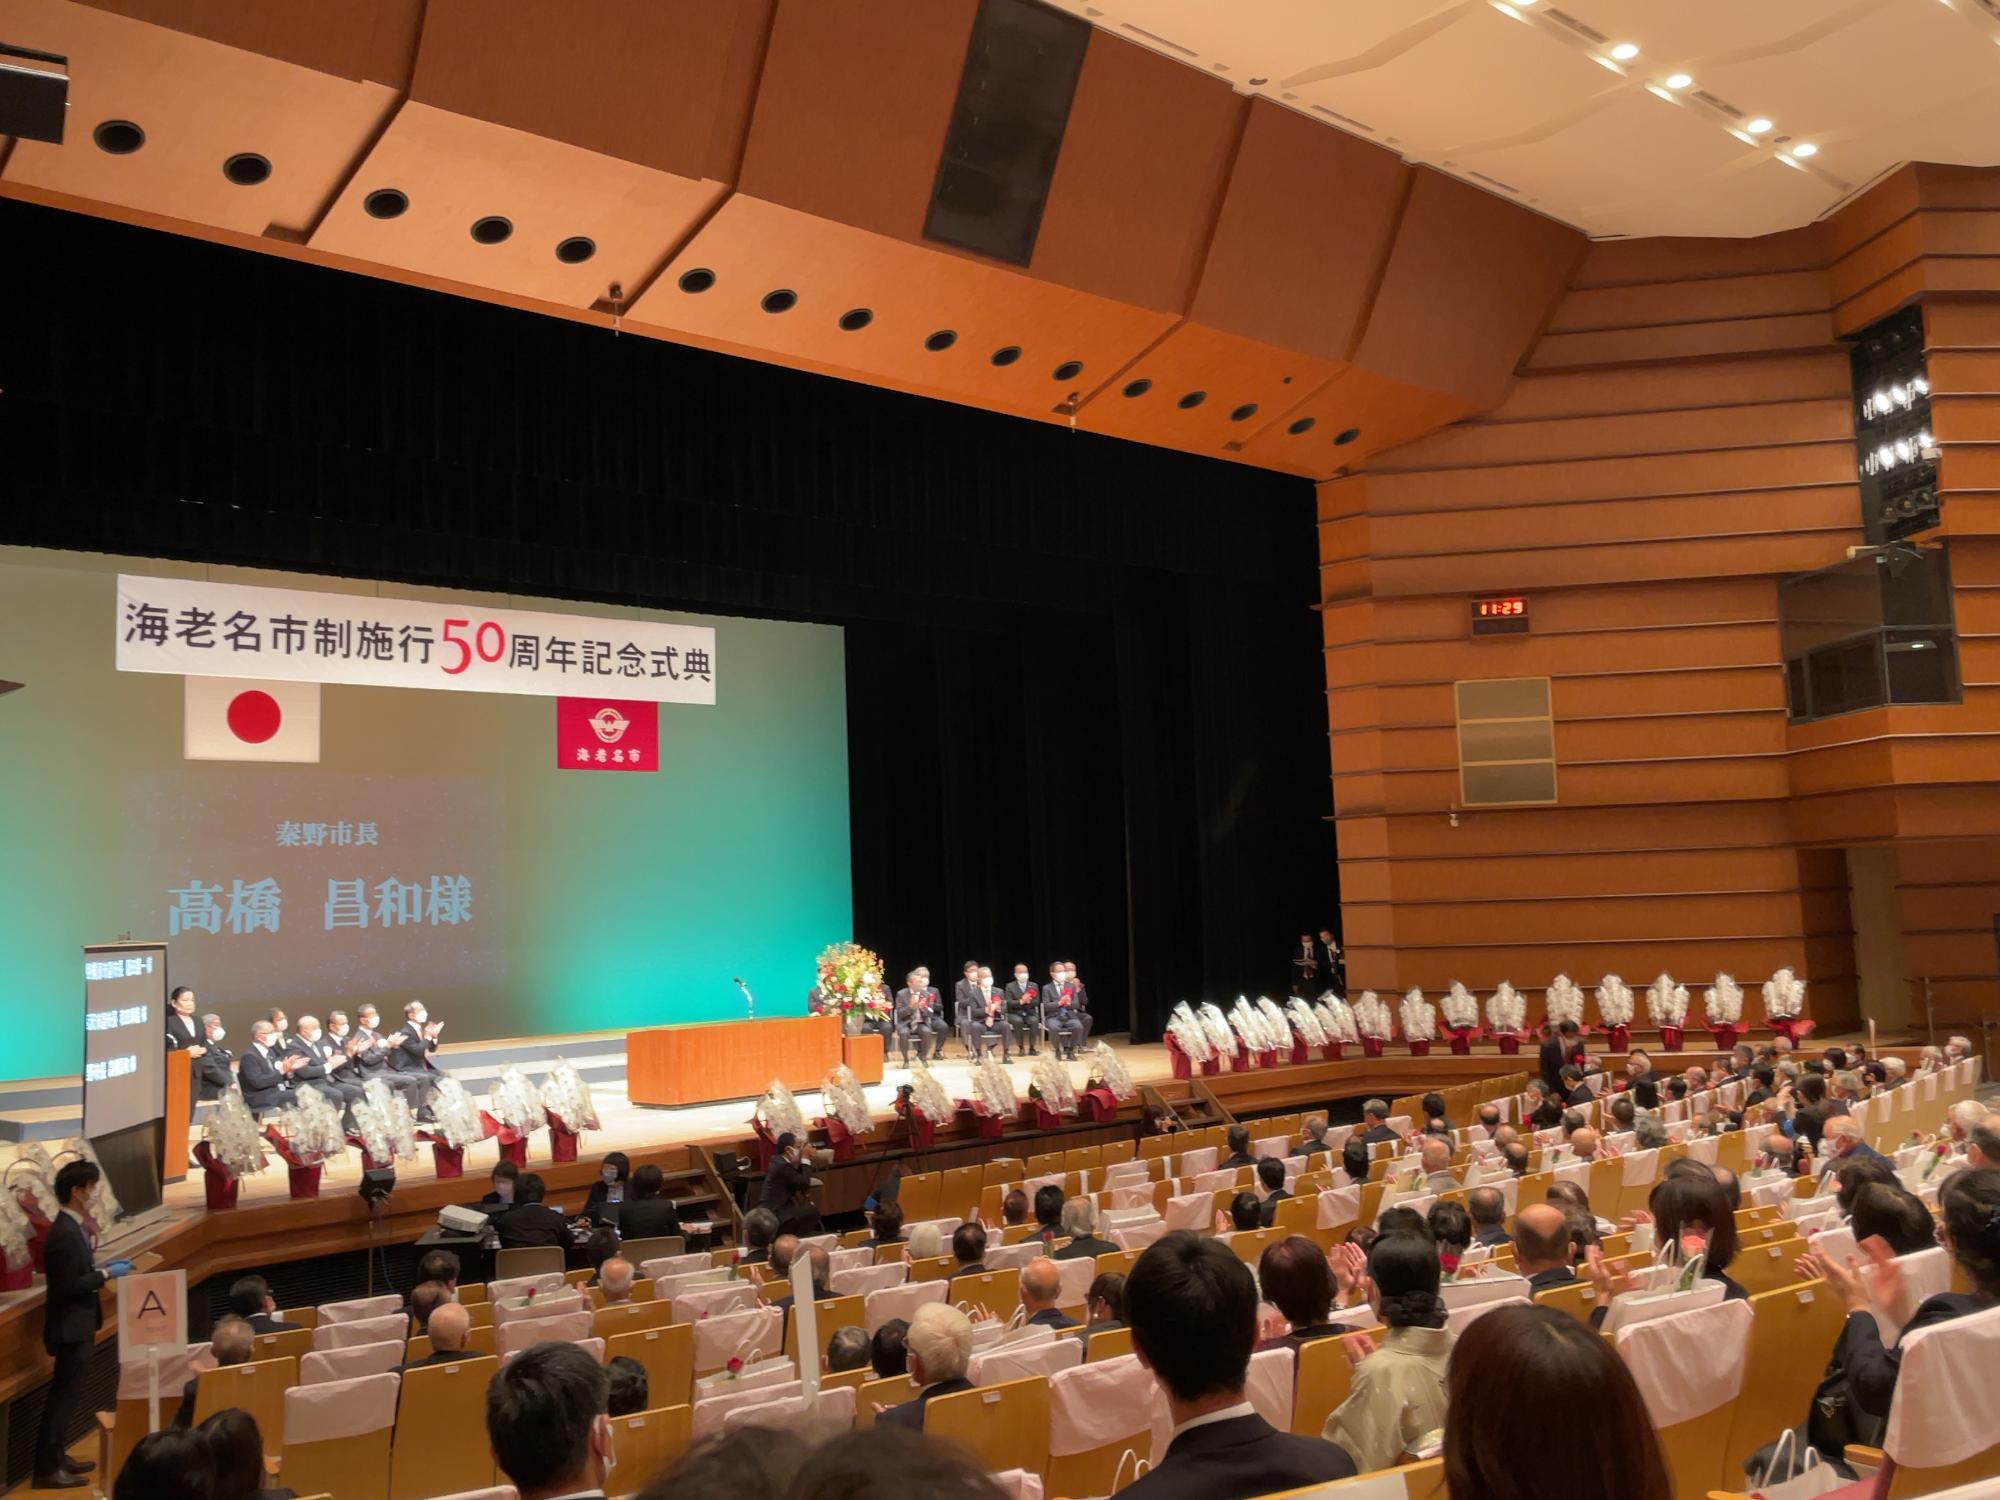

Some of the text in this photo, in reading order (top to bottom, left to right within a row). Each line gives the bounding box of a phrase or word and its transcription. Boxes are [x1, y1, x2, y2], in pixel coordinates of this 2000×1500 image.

[1481, 602, 1523, 615] 11:29
[124, 602, 712, 683] 海老名市制施行50周年記念式典
[576, 746, 641, 763] 海老名市
[276, 820, 379, 847] 秦野市長
[167, 874, 473, 936] 高橋 昌和様
[137, 1290, 166, 1319] A
